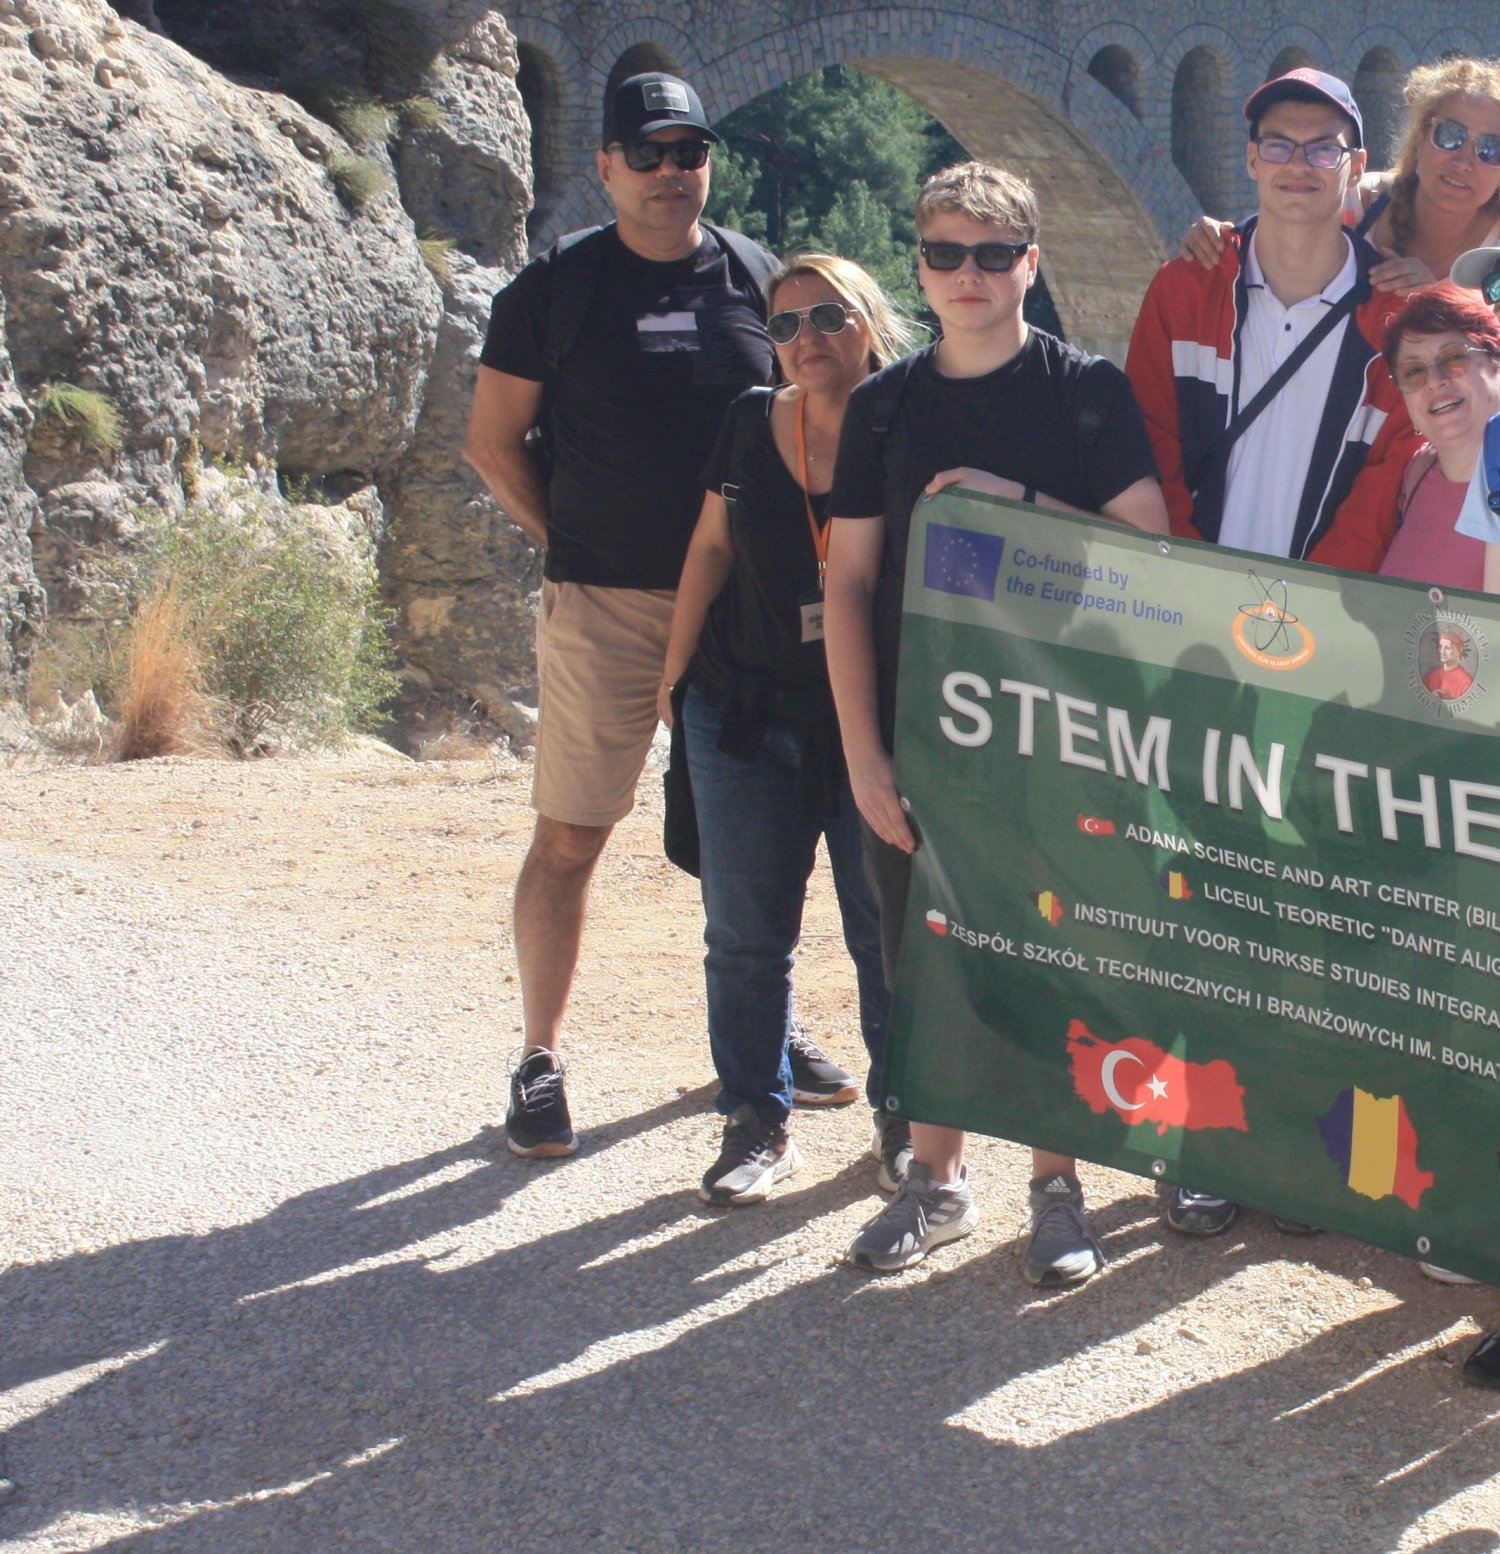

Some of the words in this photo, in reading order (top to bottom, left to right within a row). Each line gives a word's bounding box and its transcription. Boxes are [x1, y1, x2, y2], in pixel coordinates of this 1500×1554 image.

[1006, 576, 1035, 596] the
[1040, 582, 1126, 614] European
[1133, 600, 1183, 625] Union
[1014, 549, 1103, 581] Co-funded
[1109, 567, 1129, 590] by
[938, 670, 1172, 792] STEM
[1202, 727, 1286, 821] IN
[1125, 823, 1190, 855] ADANA
[1193, 841, 1277, 878] SCIENCE
[1281, 865, 1324, 888] AND
[1330, 874, 1373, 898] ART
[1377, 884, 1460, 920] CENTER
[1074, 903, 1179, 940] INSTITUUT
[1183, 925, 1241, 955] VOOR
[1246, 940, 1325, 977] TURKSE
[1330, 963, 1411, 1001] STUDIES
[1204, 882, 1271, 916] LICEUL
[1274, 901, 1375, 940] TEORETIC
[1381, 925, 1456, 962] "DANTE
[950, 920, 1018, 956] ZESPÓŁ
[1023, 942, 1089, 972] SZKÓŁ
[1095, 956, 1251, 1007] TECHNICZNYCH
[1256, 993, 1261, 1010] I
[1267, 996, 1404, 1051] BRANŻOWYCH
[1409, 1037, 1436, 1060] IM.
